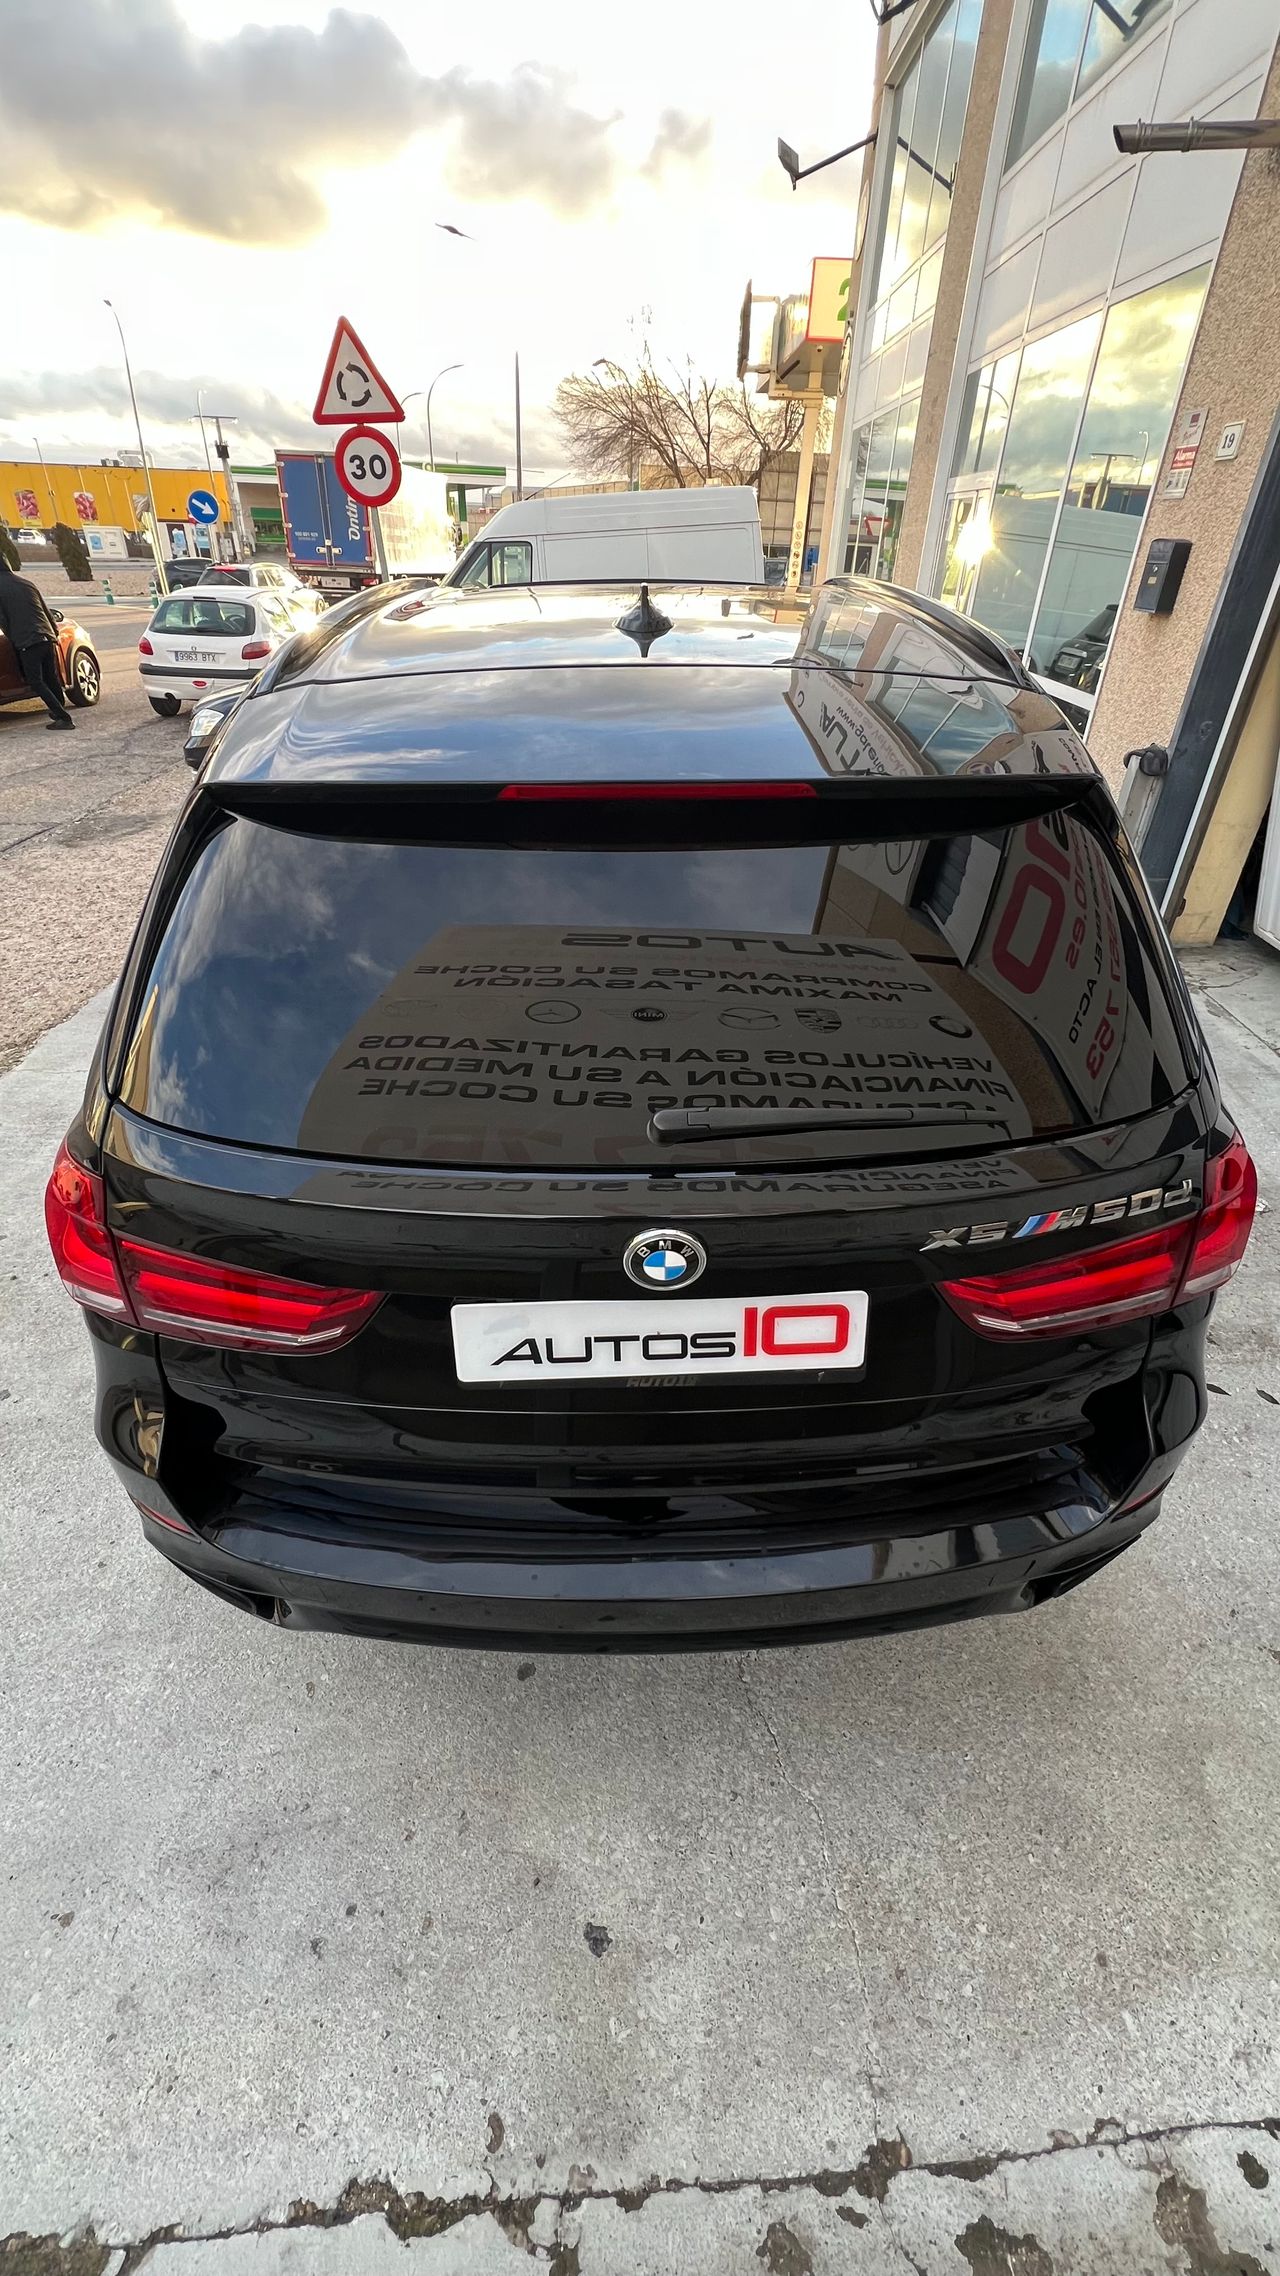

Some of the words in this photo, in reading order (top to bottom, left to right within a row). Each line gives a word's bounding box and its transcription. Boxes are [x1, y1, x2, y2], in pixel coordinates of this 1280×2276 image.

[1221, 432, 1236, 450] 19
[349, 453, 388, 481] 30
[636, 1238, 696, 1259] BMW
[919, 1221, 1009, 1252] X5
